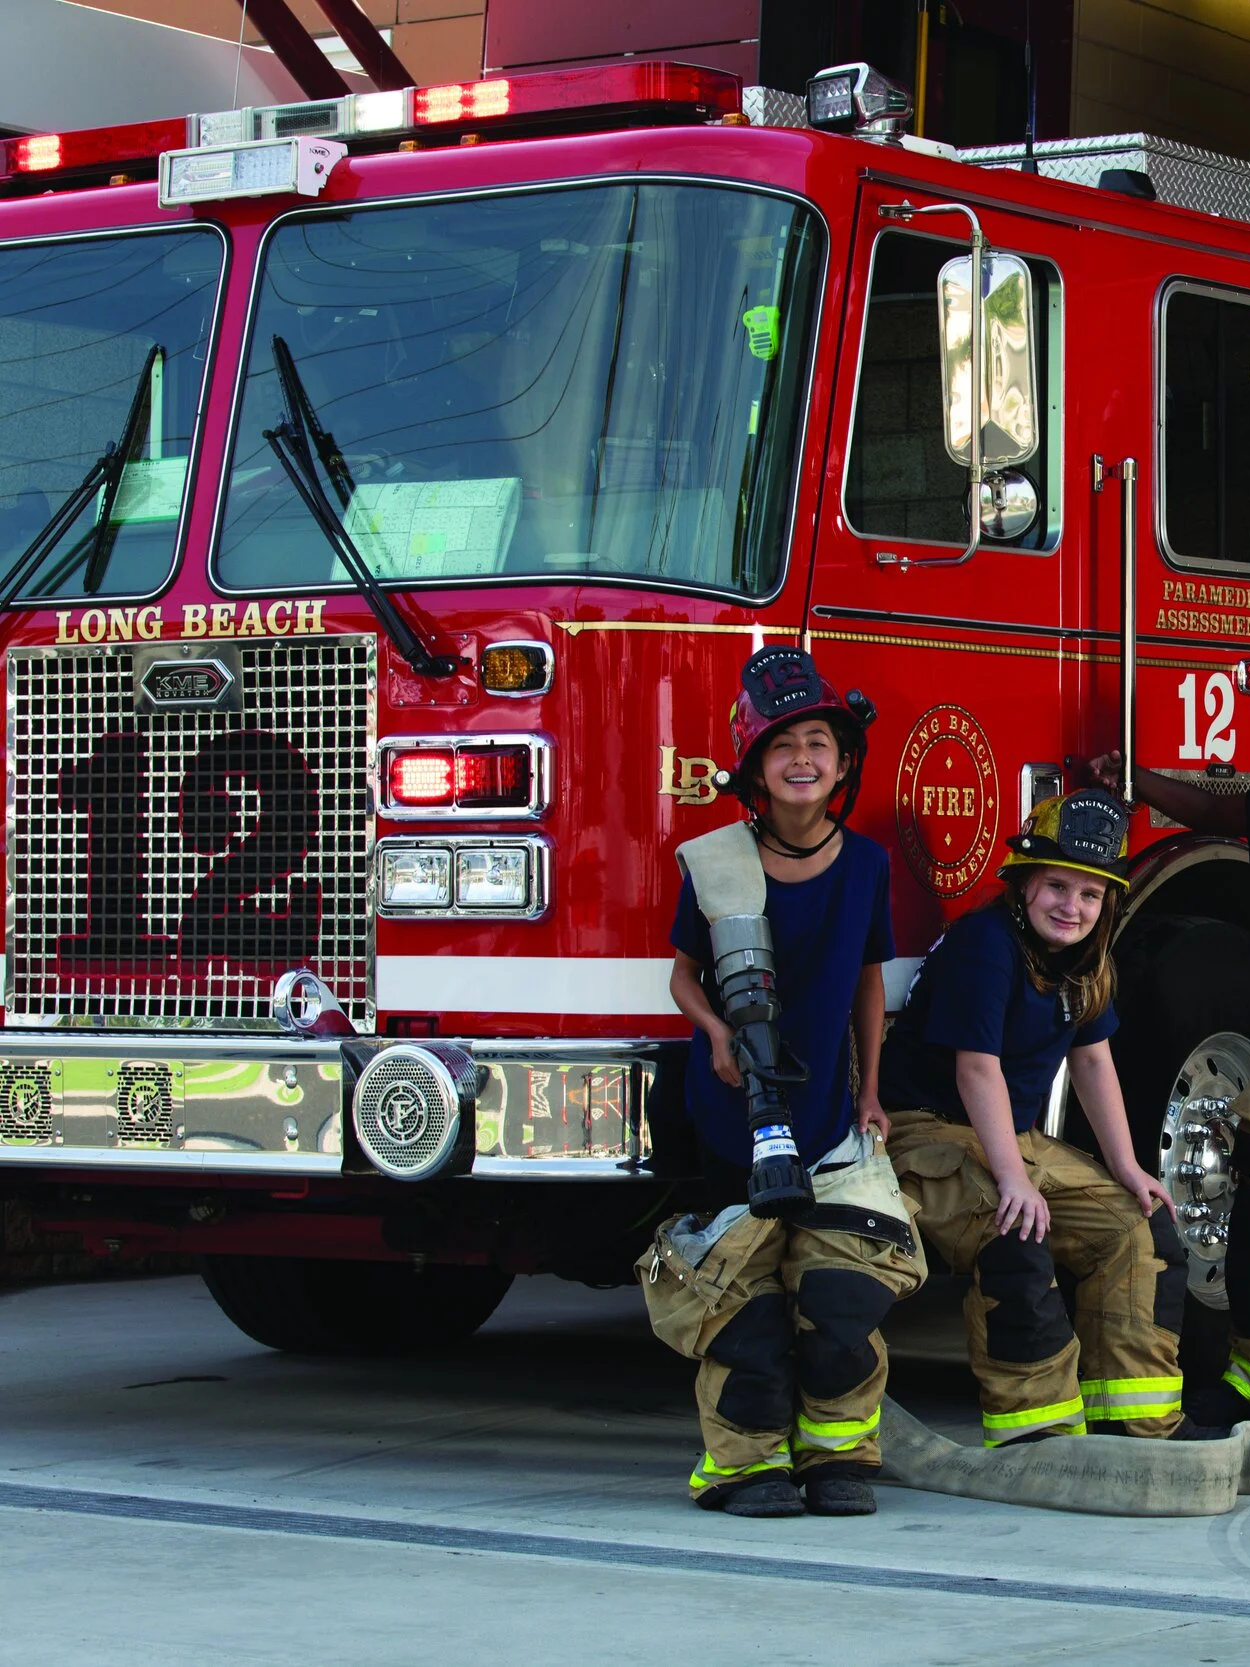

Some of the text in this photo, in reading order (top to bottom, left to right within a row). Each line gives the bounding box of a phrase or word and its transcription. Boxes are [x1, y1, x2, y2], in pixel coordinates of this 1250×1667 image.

[55, 600, 327, 644] LONG BEACH
[750, 652, 800, 673] CAPTAIN
[755, 662, 809, 695] 12
[155, 674, 208, 691] KME
[775, 690, 808, 706] LBFD
[1178, 672, 1236, 762] 12
[905, 714, 993, 778] LONG BEACH
[657, 745, 719, 805] LB
[921, 785, 976, 817] FIRE
[1071, 799, 1121, 821] ENGINEER
[57, 729, 322, 979] 12
[904, 826, 991, 888] DEPARTMENT
[1074, 839, 1105, 853] LBFD
